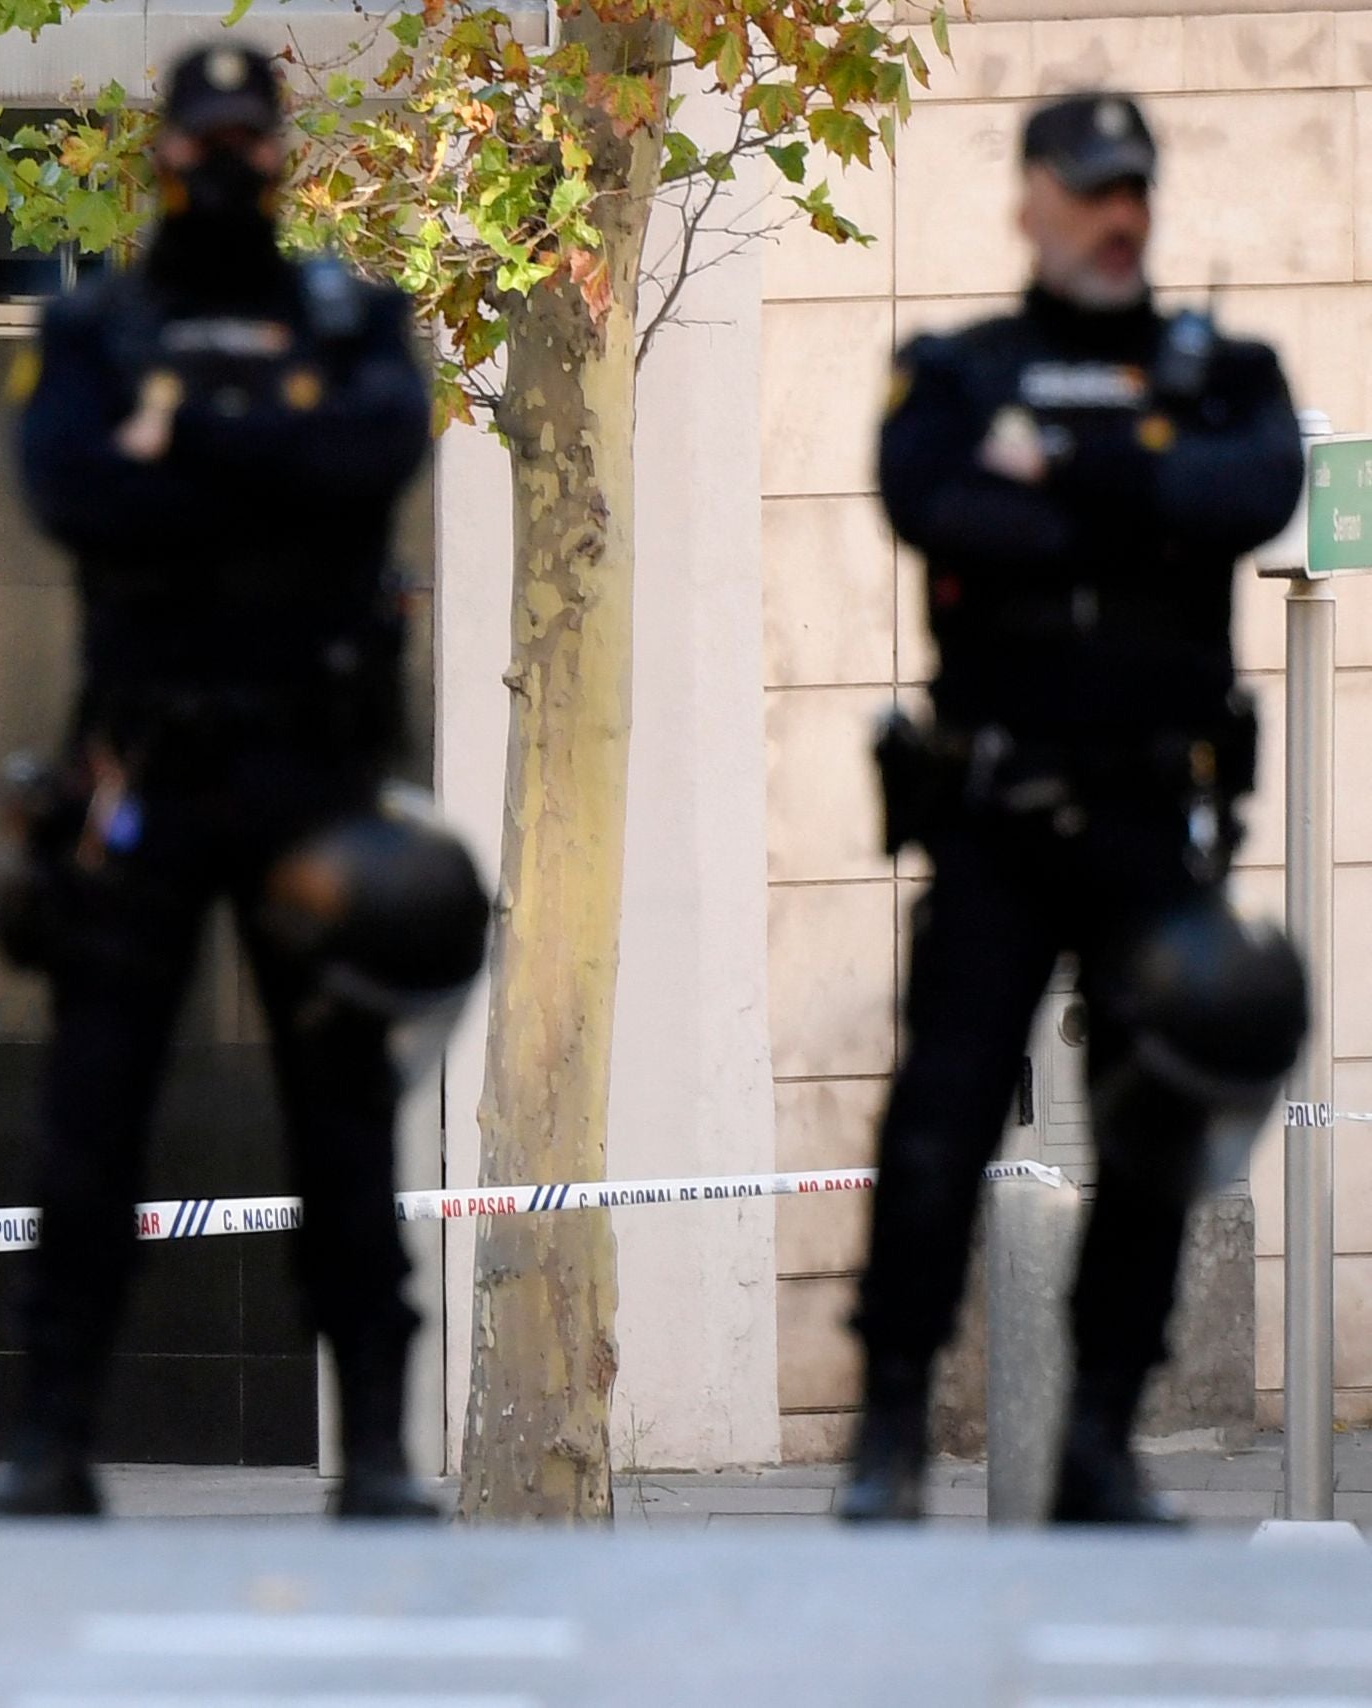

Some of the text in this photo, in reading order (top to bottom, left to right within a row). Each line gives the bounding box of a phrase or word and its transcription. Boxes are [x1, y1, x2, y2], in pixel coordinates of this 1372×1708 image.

[441, 1195, 517, 1218] NO PASAR
[223, 1209, 238, 1231] C.
